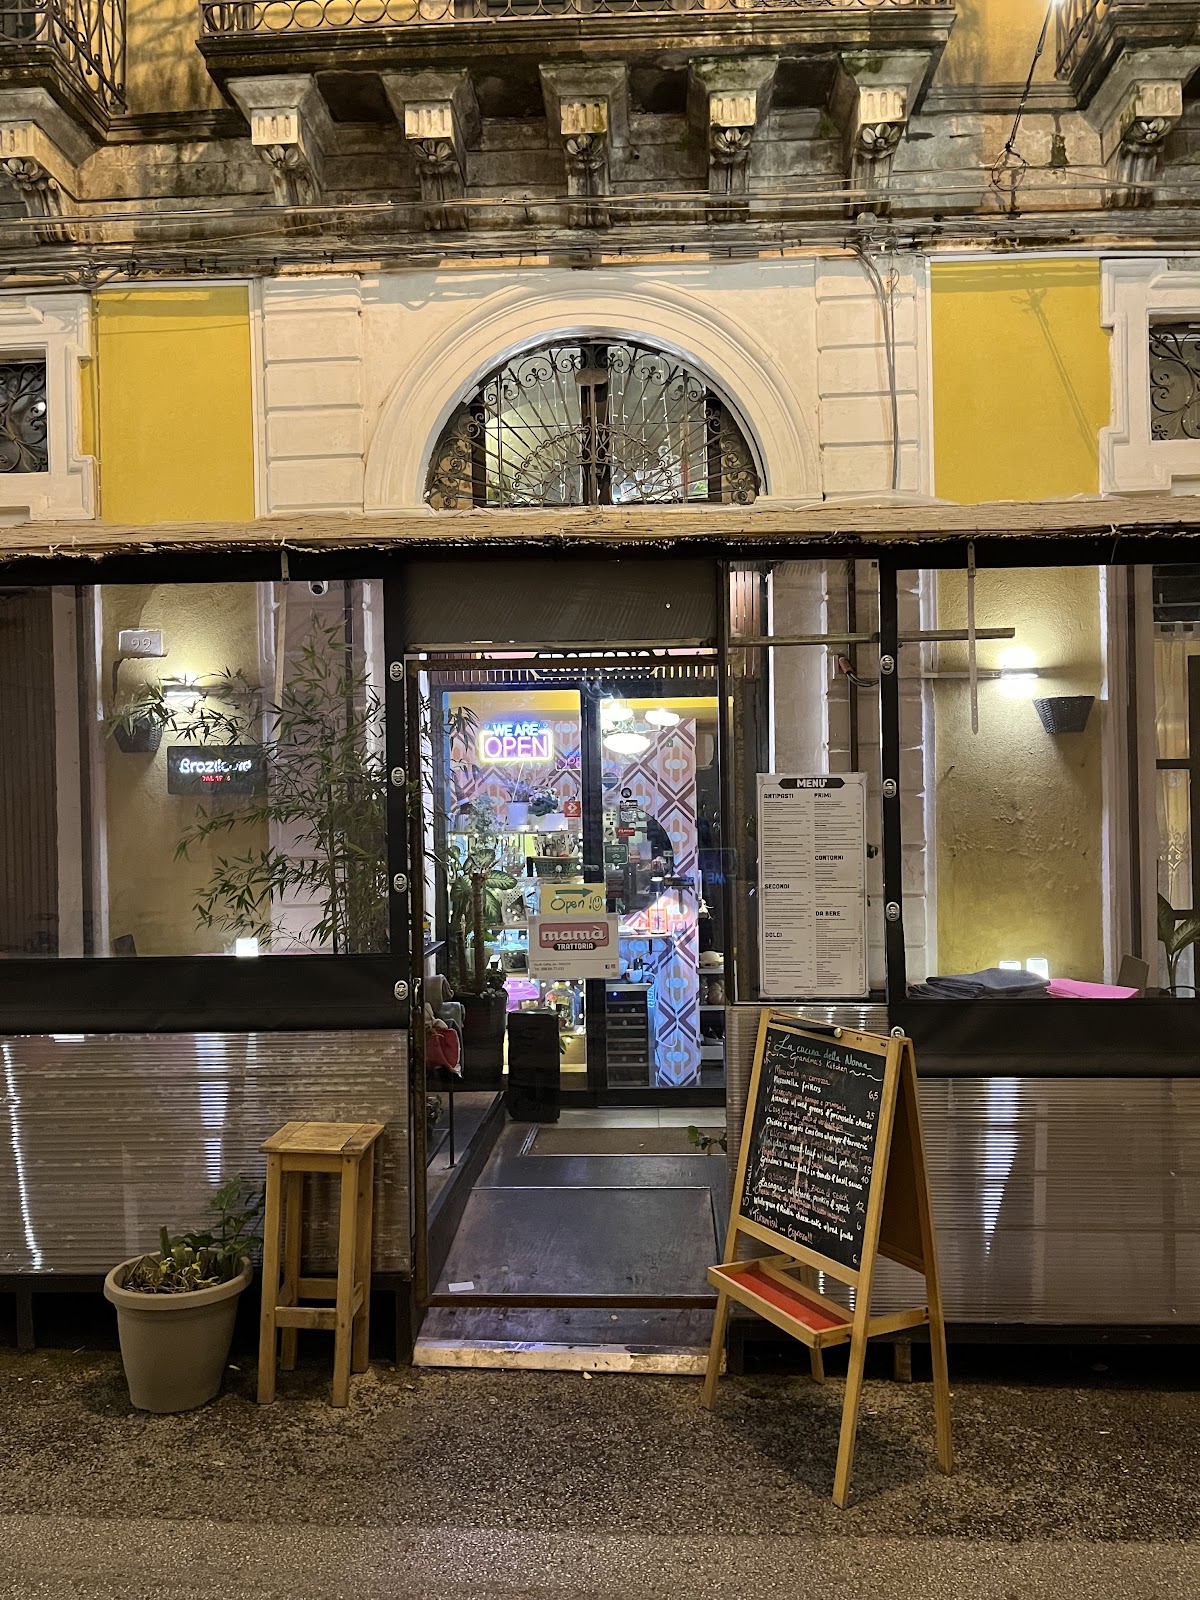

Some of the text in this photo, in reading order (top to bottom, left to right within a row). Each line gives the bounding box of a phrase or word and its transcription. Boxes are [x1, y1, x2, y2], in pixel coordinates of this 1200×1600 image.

[131, 637, 152, 653] 22
[493, 723, 540, 737] WE ARE
[484, 736, 548, 758] OPEN
[551, 898, 585, 914] Open
[541, 925, 607, 942] mamà
[774, 1034, 795, 1052] La
[797, 1046, 821, 1057] cucina
[823, 1048, 841, 1063] della
[845, 1054, 873, 1071] Nonna
[856, 1221, 862, 1231] 6
